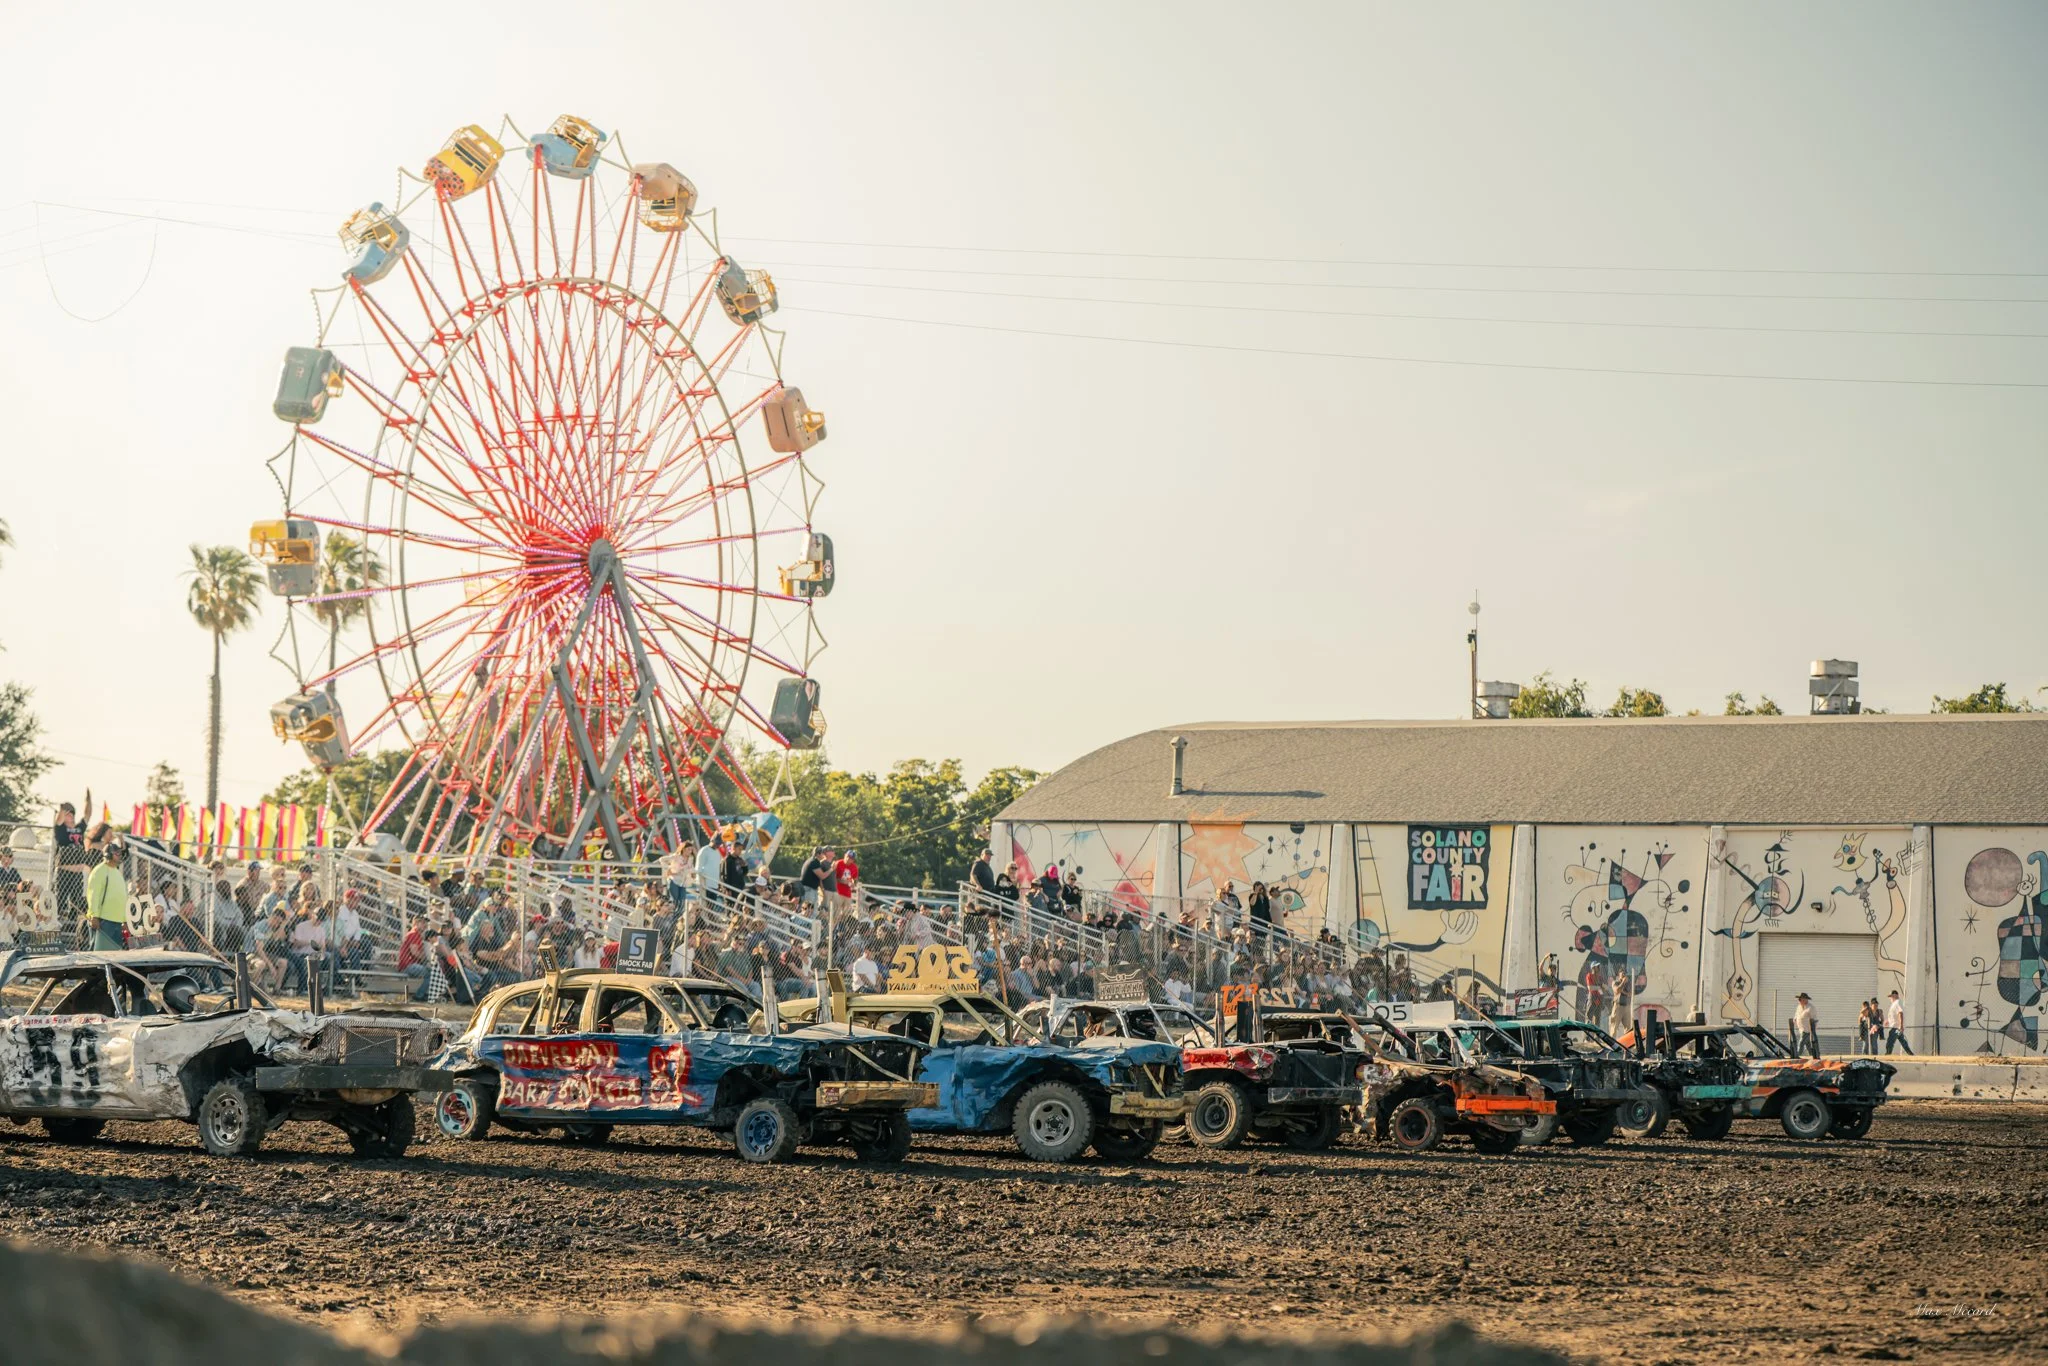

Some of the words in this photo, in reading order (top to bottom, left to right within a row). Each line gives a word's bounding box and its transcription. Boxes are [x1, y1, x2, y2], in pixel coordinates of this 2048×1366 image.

[1411, 830, 1486, 847] SOLANO
[1412, 848, 1485, 864] COUNTY
[16, 890, 60, 931] 59
[641, 961, 654, 969] FAB
